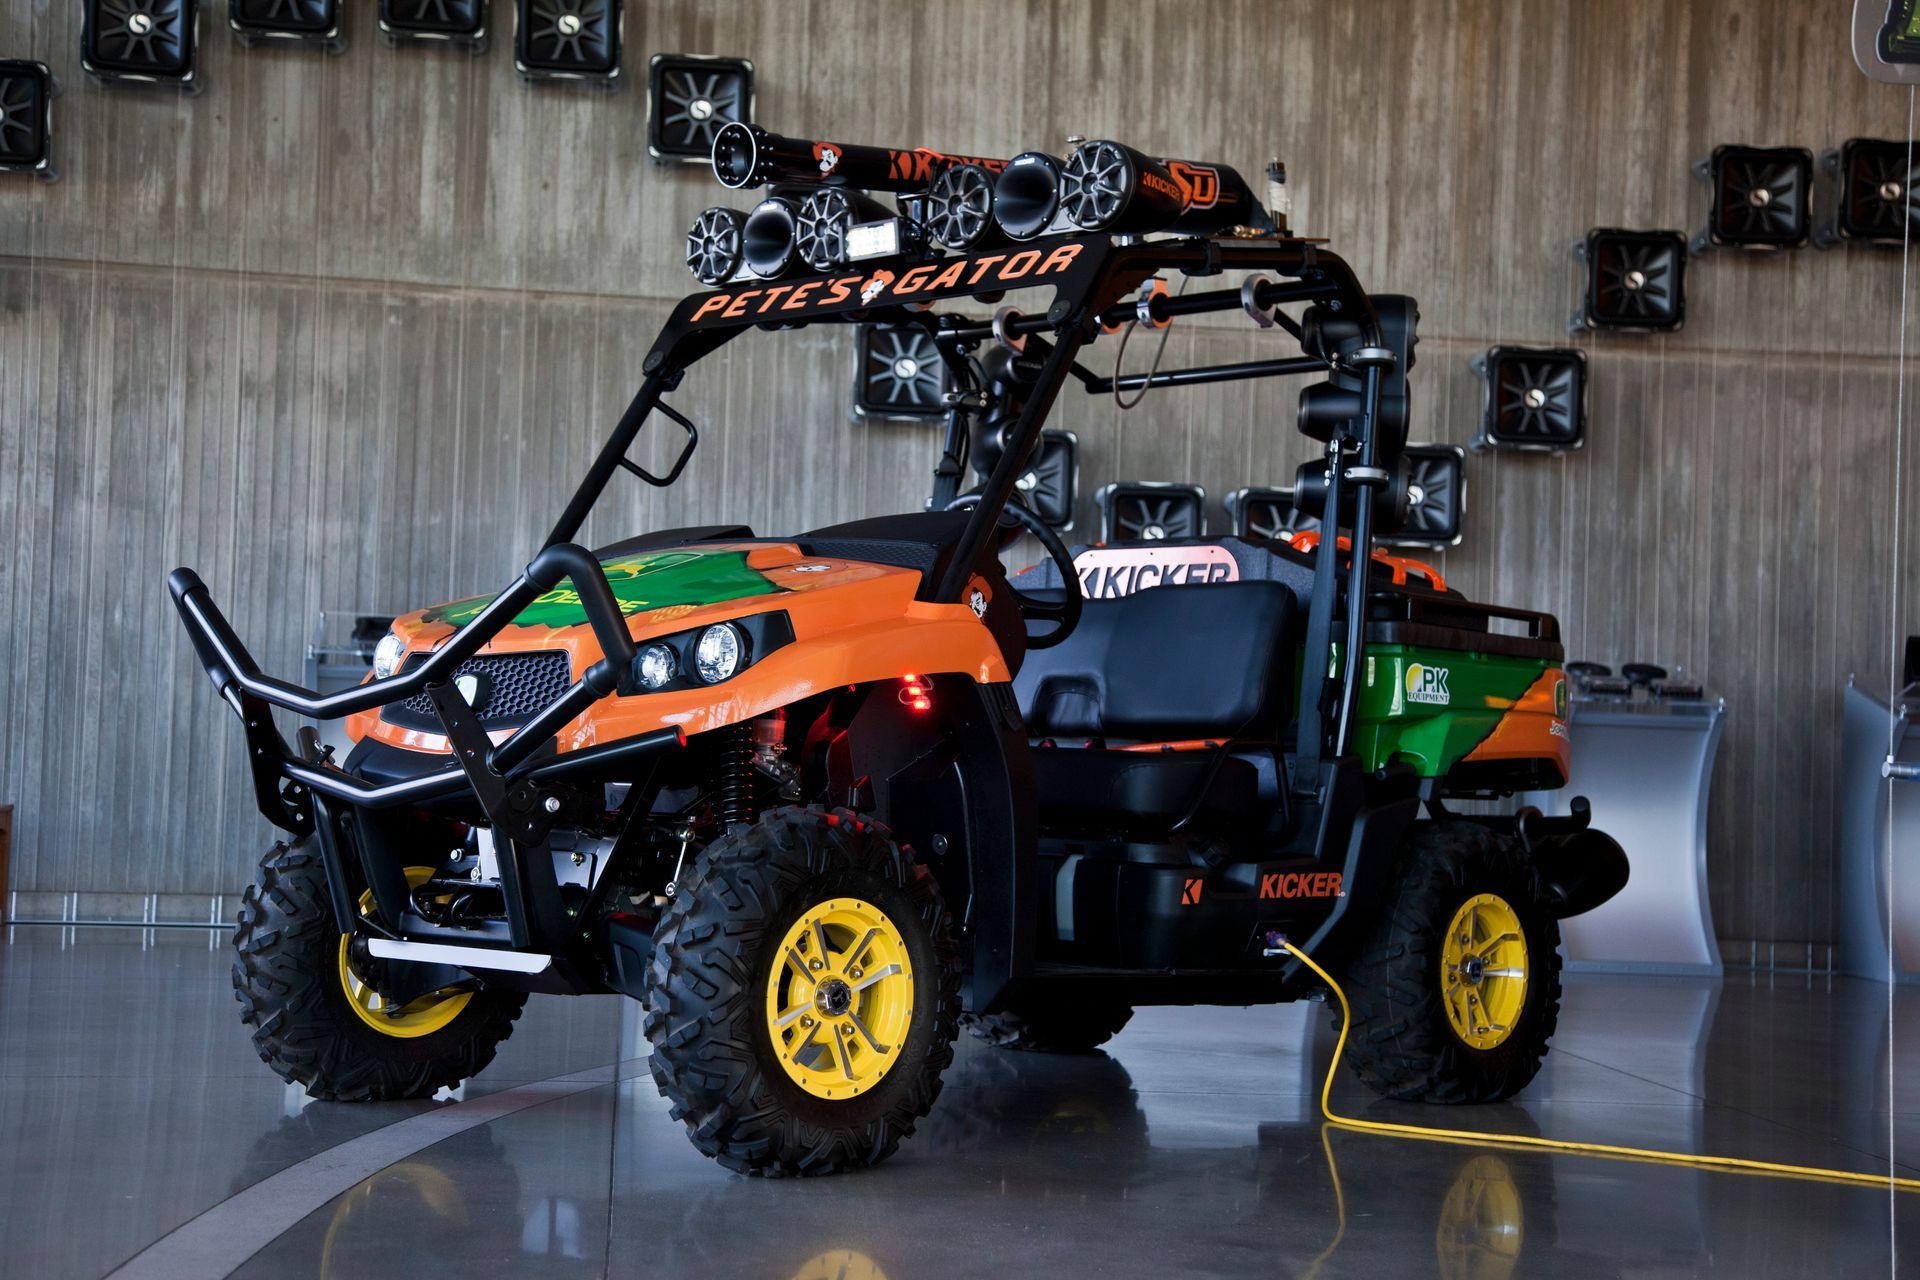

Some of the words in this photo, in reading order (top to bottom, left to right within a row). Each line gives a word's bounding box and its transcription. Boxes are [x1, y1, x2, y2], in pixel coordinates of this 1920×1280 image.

[690, 276, 864, 322] PETE'S
[892, 244, 1084, 295] GATOR
[1408, 692, 1448, 703] EQUIPMENT
[1259, 872, 1343, 899] KICKER
